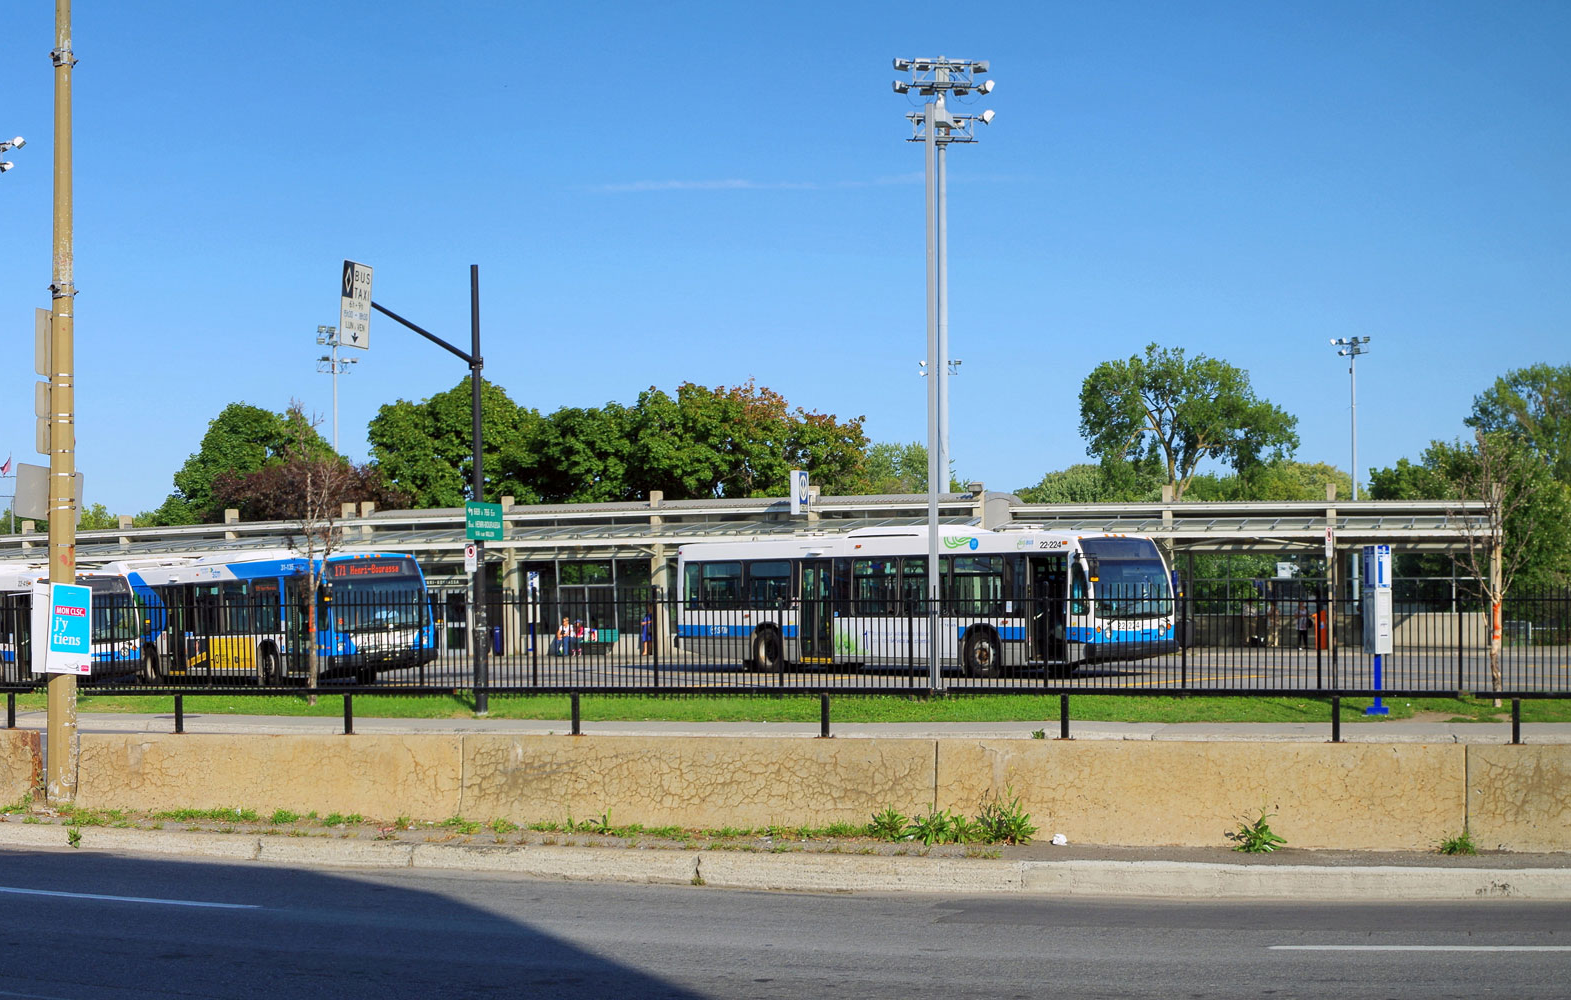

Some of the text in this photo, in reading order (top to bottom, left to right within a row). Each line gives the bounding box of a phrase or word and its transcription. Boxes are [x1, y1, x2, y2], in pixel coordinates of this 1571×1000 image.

[354, 270, 371, 285] BUS
[354, 287, 370, 302] TAXI
[1039, 541, 1062, 549] 22-224
[334, 564, 399, 576] 171 Henri-Bourassa
[56, 606, 85, 617] MON CLSC,
[53, 617, 68, 632] j'y
[53, 632, 81, 646] tiens
